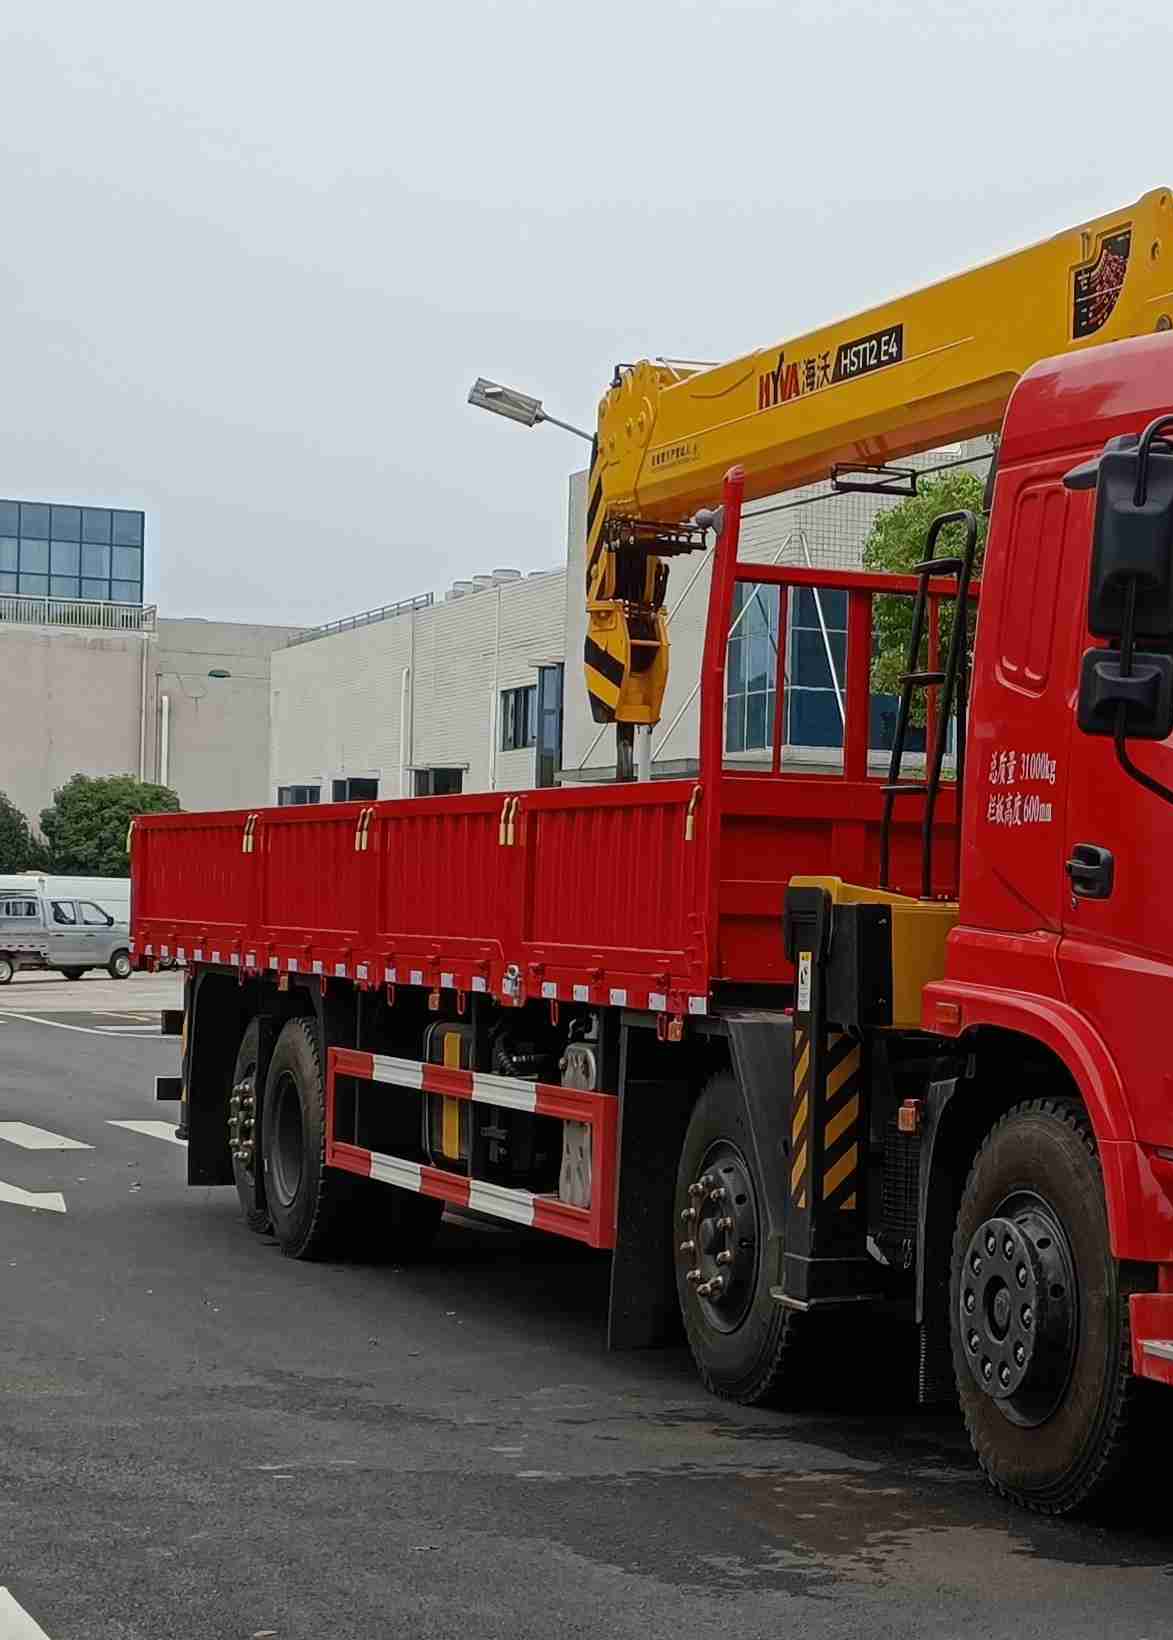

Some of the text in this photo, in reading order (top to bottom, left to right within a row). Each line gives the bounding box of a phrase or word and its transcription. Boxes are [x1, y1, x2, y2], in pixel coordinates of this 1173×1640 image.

[759, 350, 800, 409] HYVA
[801, 350, 831, 394] 海沃
[880, 332, 898, 362] E4
[989, 750, 1056, 784] 总质量 31000kg
[1023, 794, 1052, 822] 600mm
